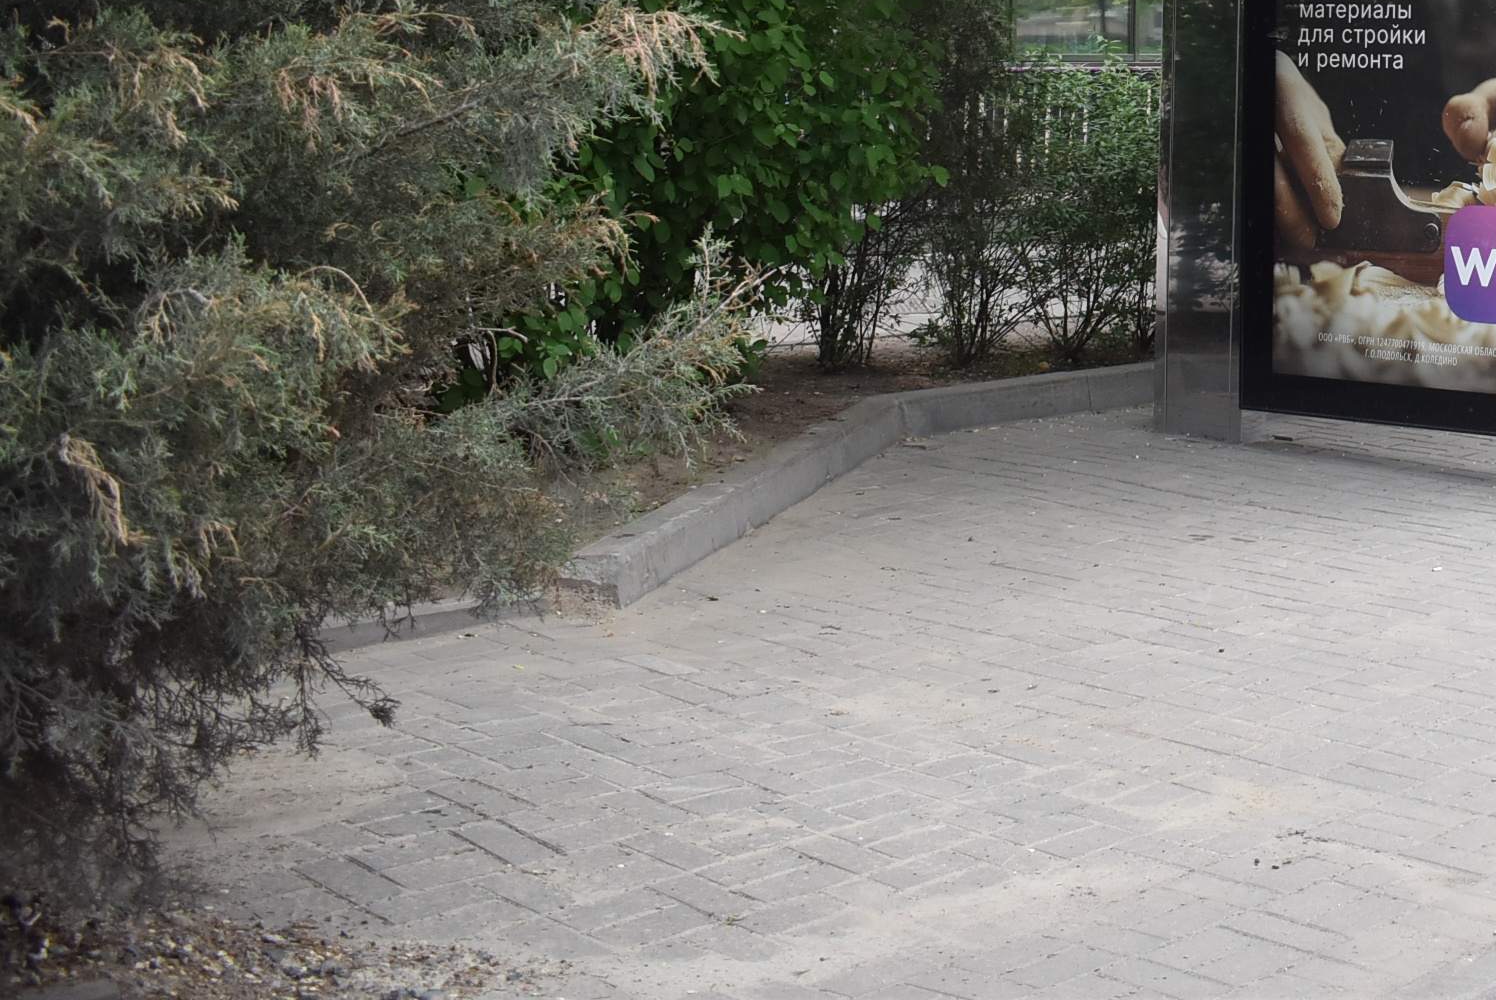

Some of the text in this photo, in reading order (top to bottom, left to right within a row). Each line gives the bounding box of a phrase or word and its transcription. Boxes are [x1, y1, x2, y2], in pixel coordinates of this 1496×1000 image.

[1299, 2, 1412, 23] материалы
[1297, 23, 1426, 47] для стройки
[1298, 51, 1404, 72] и ремонта
[1428, 342, 1473, 355] МОСКОВСКАЯ
